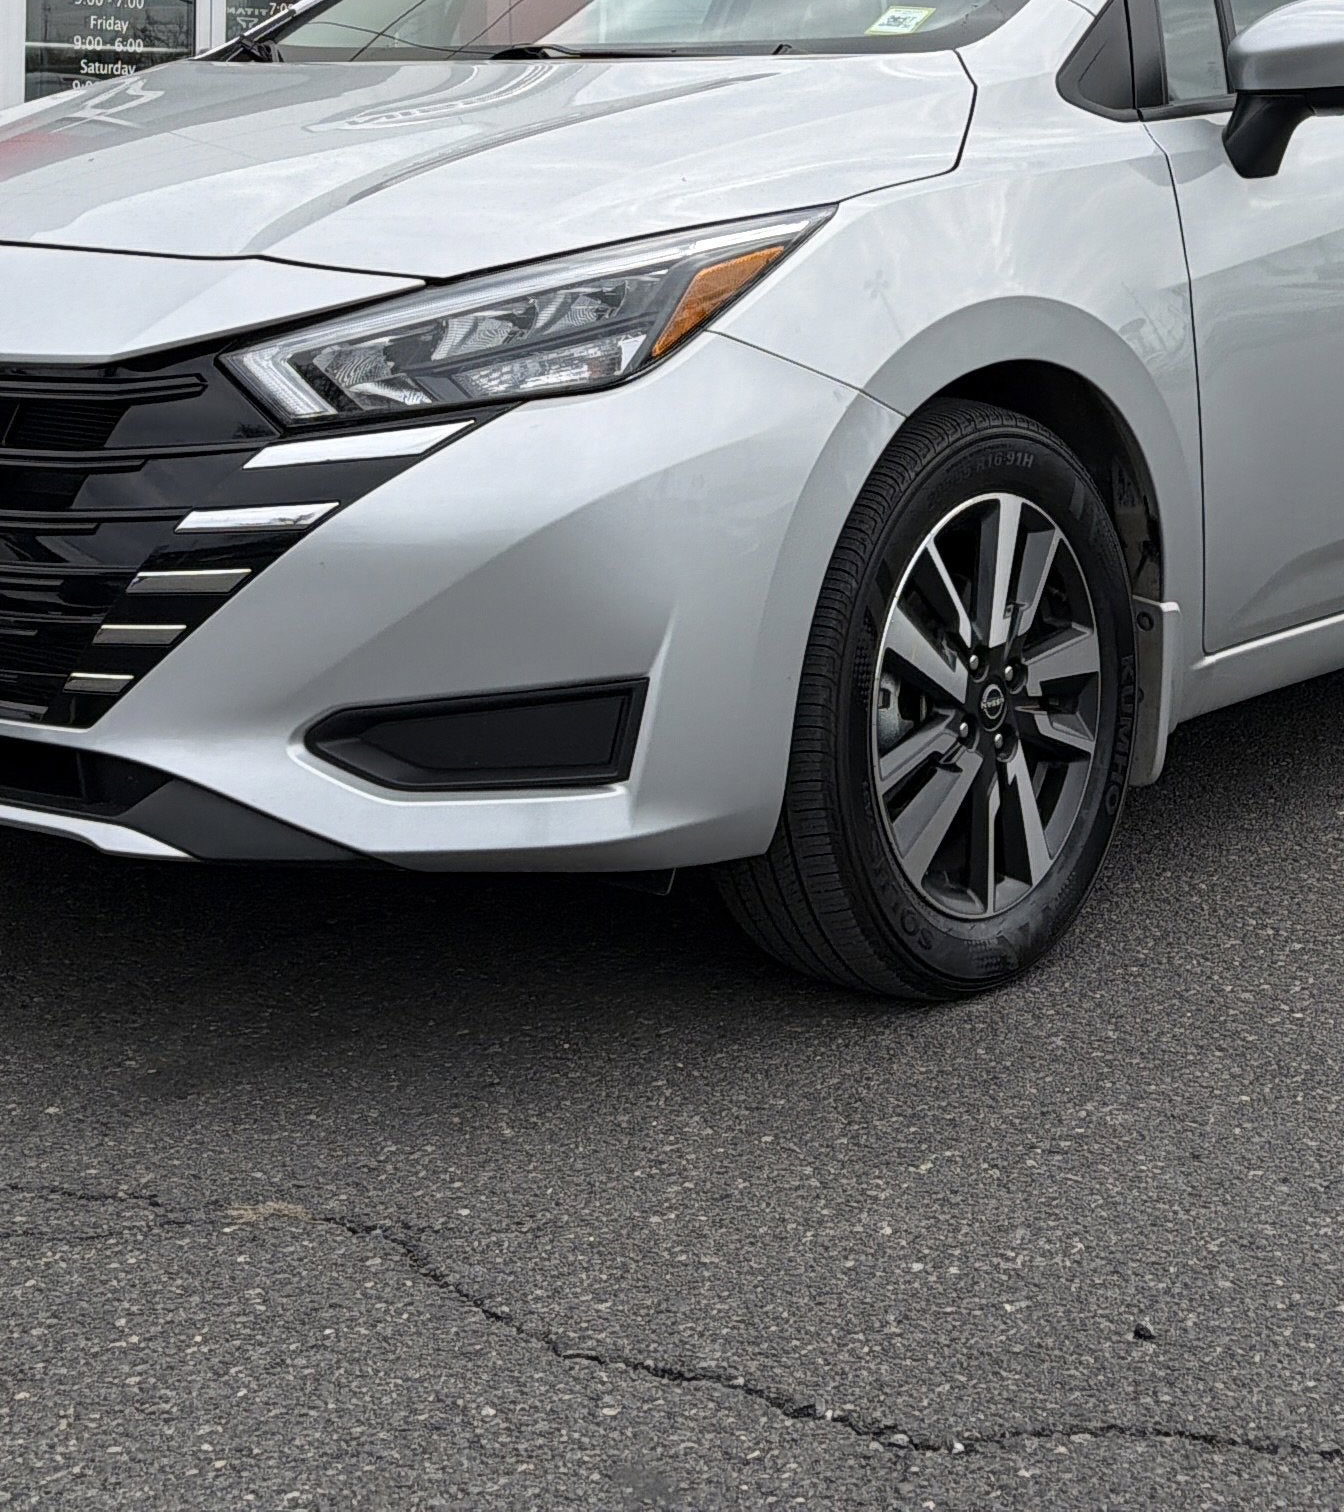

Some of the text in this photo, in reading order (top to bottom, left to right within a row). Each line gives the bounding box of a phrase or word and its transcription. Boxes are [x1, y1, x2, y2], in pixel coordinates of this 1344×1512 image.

[89, 15, 129, 34] Friday
[73, 35, 103, 51] 9:00
[114, 37, 144, 53] 6:00
[80, 59, 136, 76] Saturday
[1105, 655, 1135, 815] KUMHO
